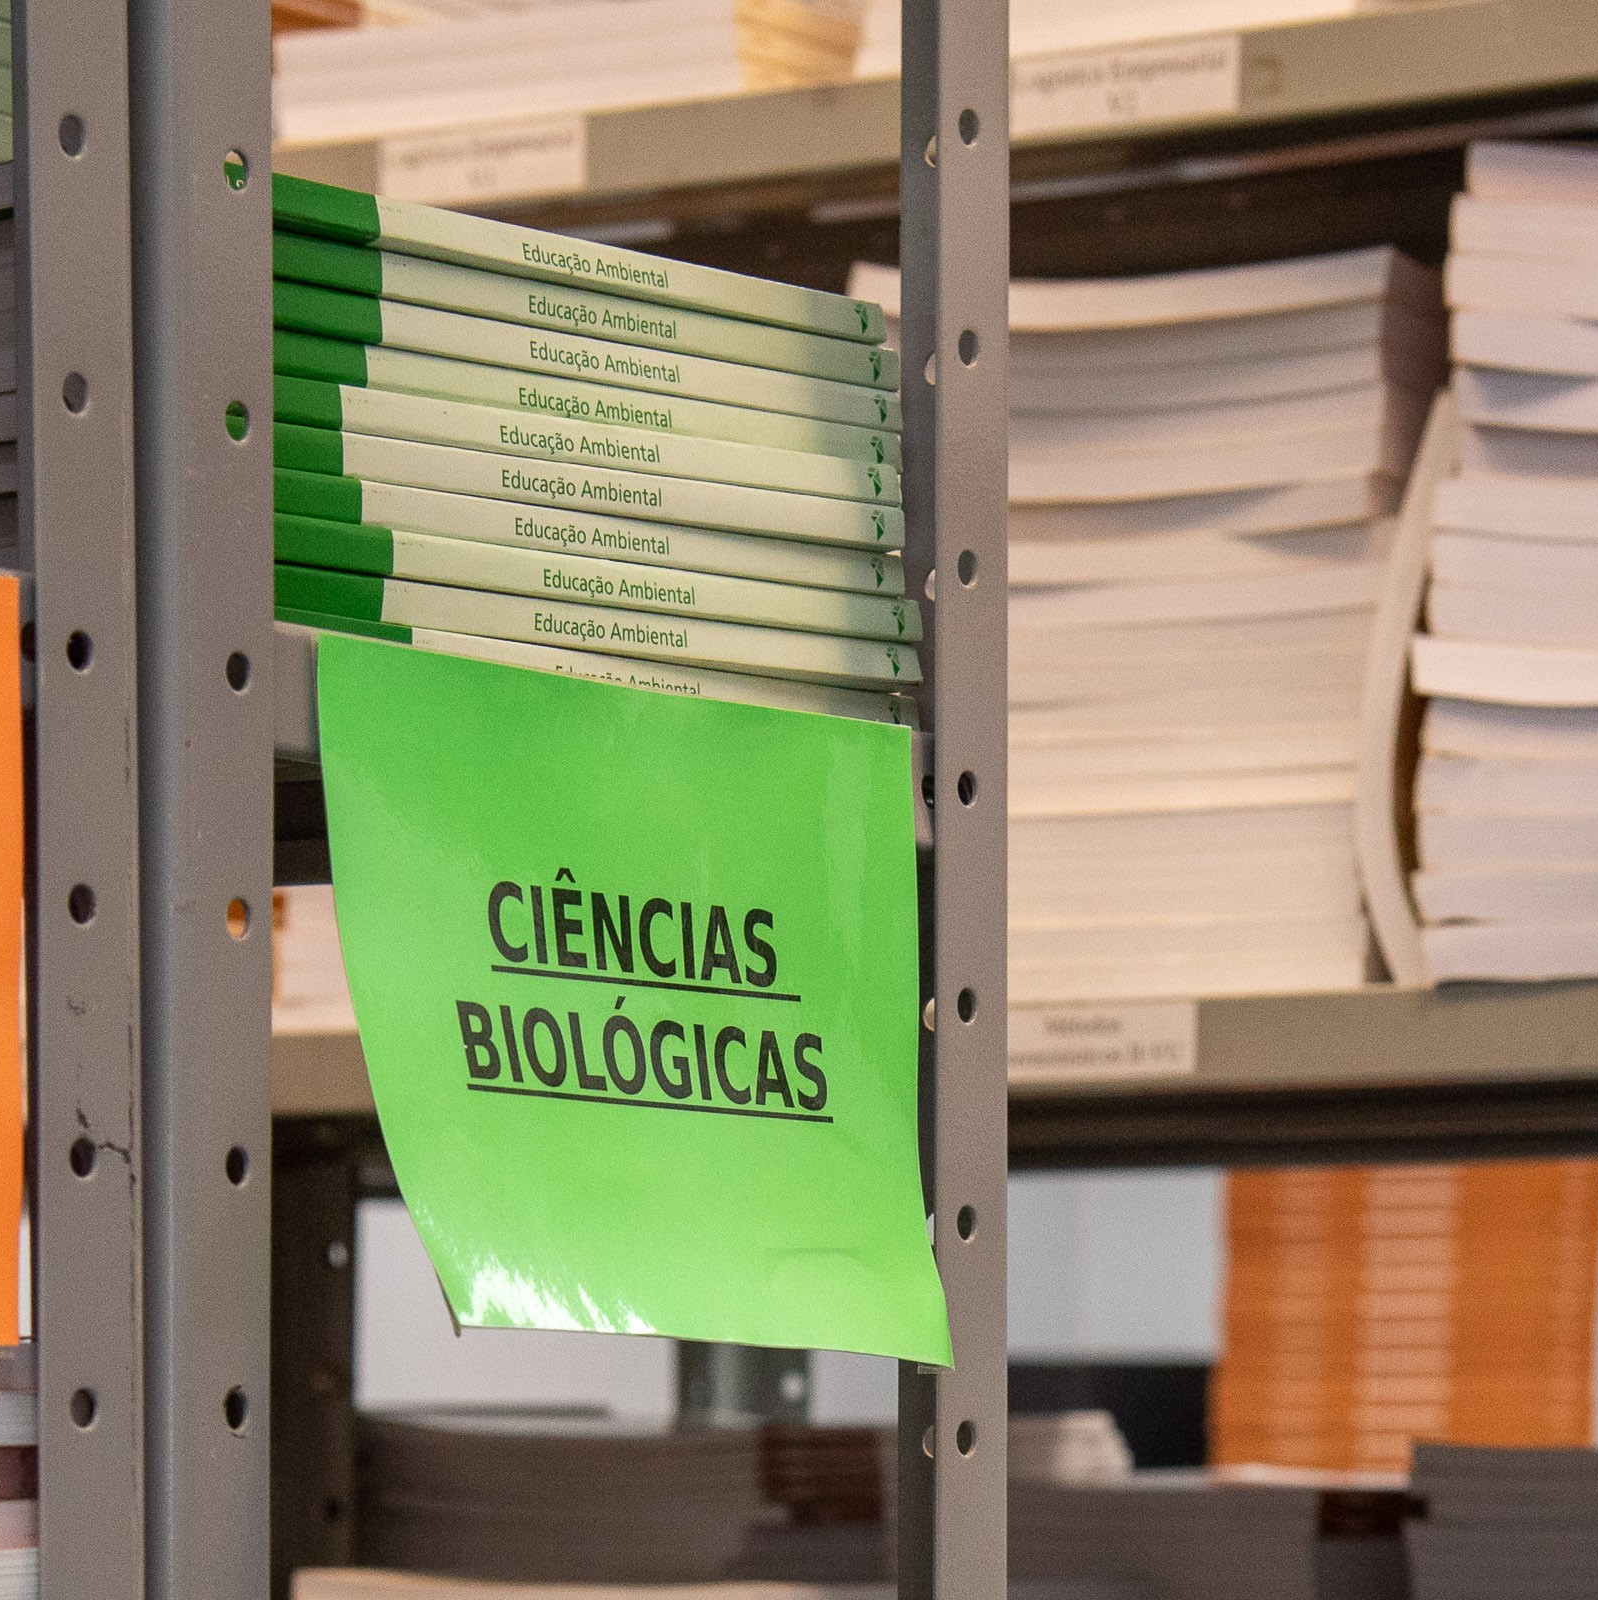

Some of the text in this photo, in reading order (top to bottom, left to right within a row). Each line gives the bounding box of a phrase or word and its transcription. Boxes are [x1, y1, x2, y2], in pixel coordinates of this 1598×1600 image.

[522, 243, 669, 289] Educação Ambiental
[529, 295, 677, 339] Educação Ambiental
[530, 341, 680, 383] Educação Ambiental
[519, 387, 672, 428] Educação Ambiental
[500, 425, 660, 463] Educação Ambiental
[502, 469, 662, 507] Educação Ambiental
[515, 518, 670, 555] Educação Ambiental
[544, 569, 696, 605] Educação Ambiental
[535, 613, 688, 648] Educação Ambiental
[487, 867, 778, 988] CIÊNCIAS
[456, 996, 828, 1112] BIOLÓGICAS
